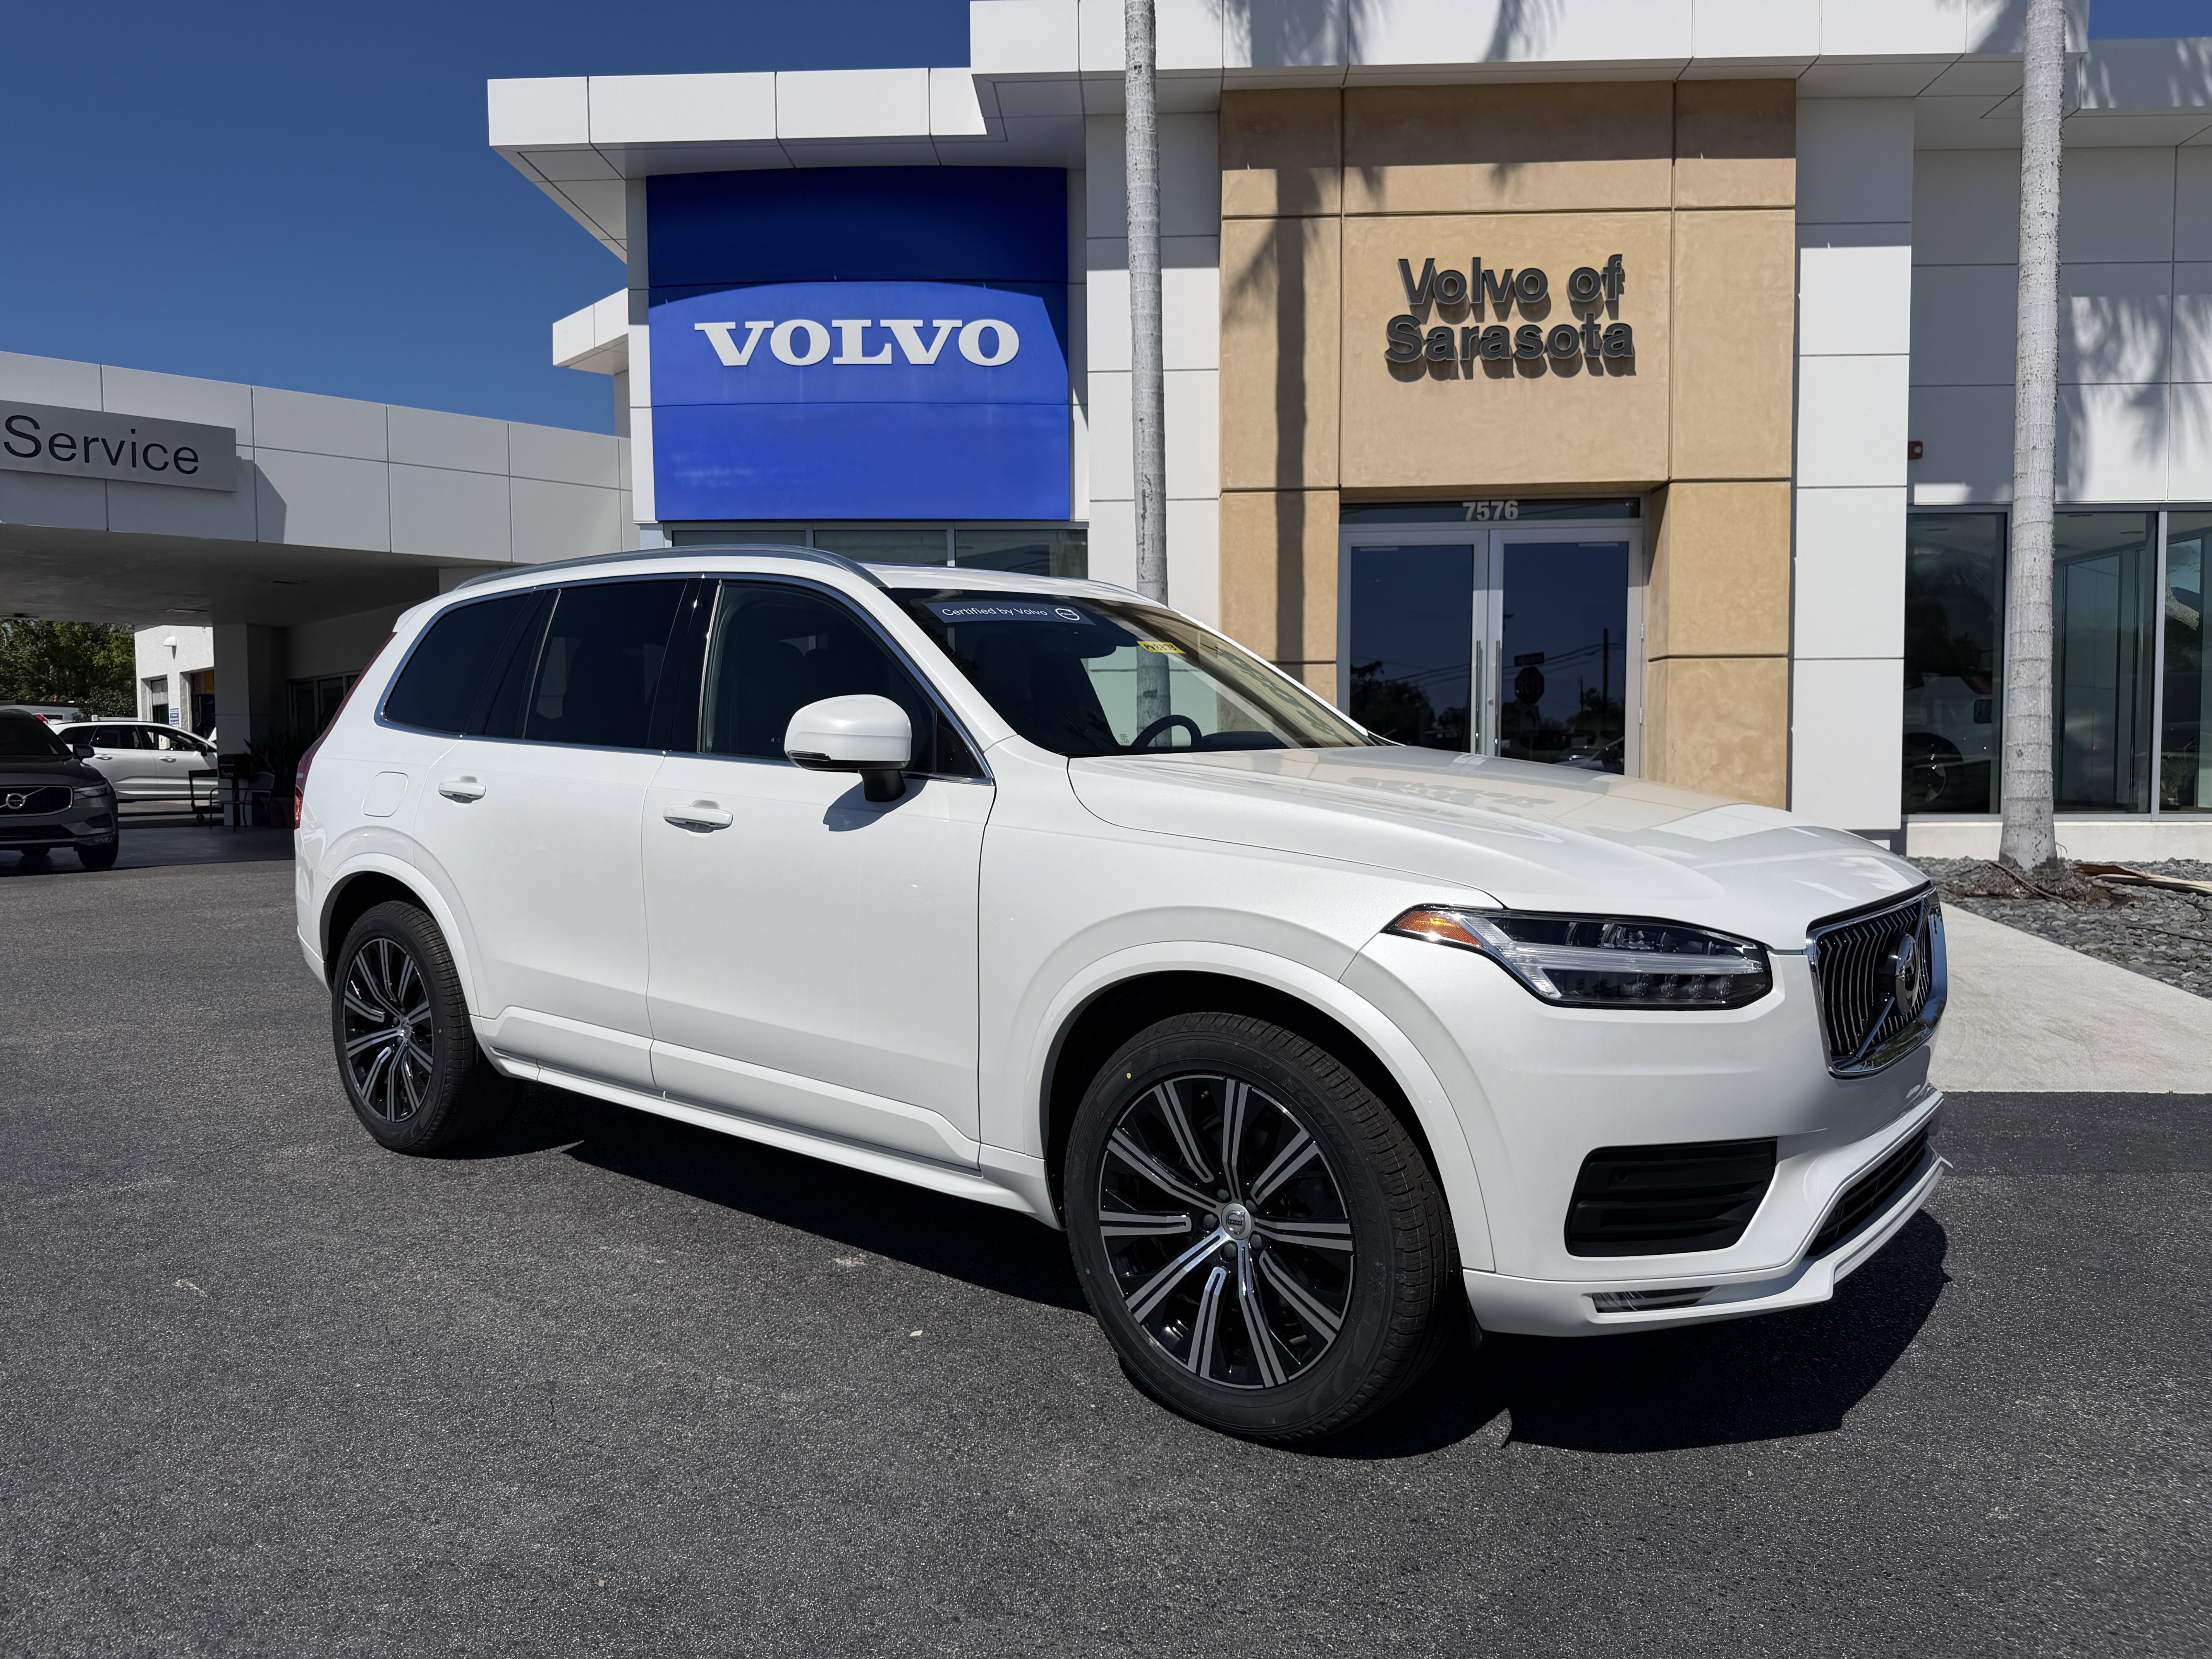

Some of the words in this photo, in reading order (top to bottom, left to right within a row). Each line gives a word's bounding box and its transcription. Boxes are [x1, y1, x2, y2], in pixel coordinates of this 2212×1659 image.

[1397, 257, 1548, 304] Volvo
[1566, 254, 1623, 302] of
[694, 319, 1019, 366] VOLVO
[1384, 313, 1634, 362] Sarasota
[3, 414, 199, 474] Service
[1462, 500, 1518, 522] 7576
